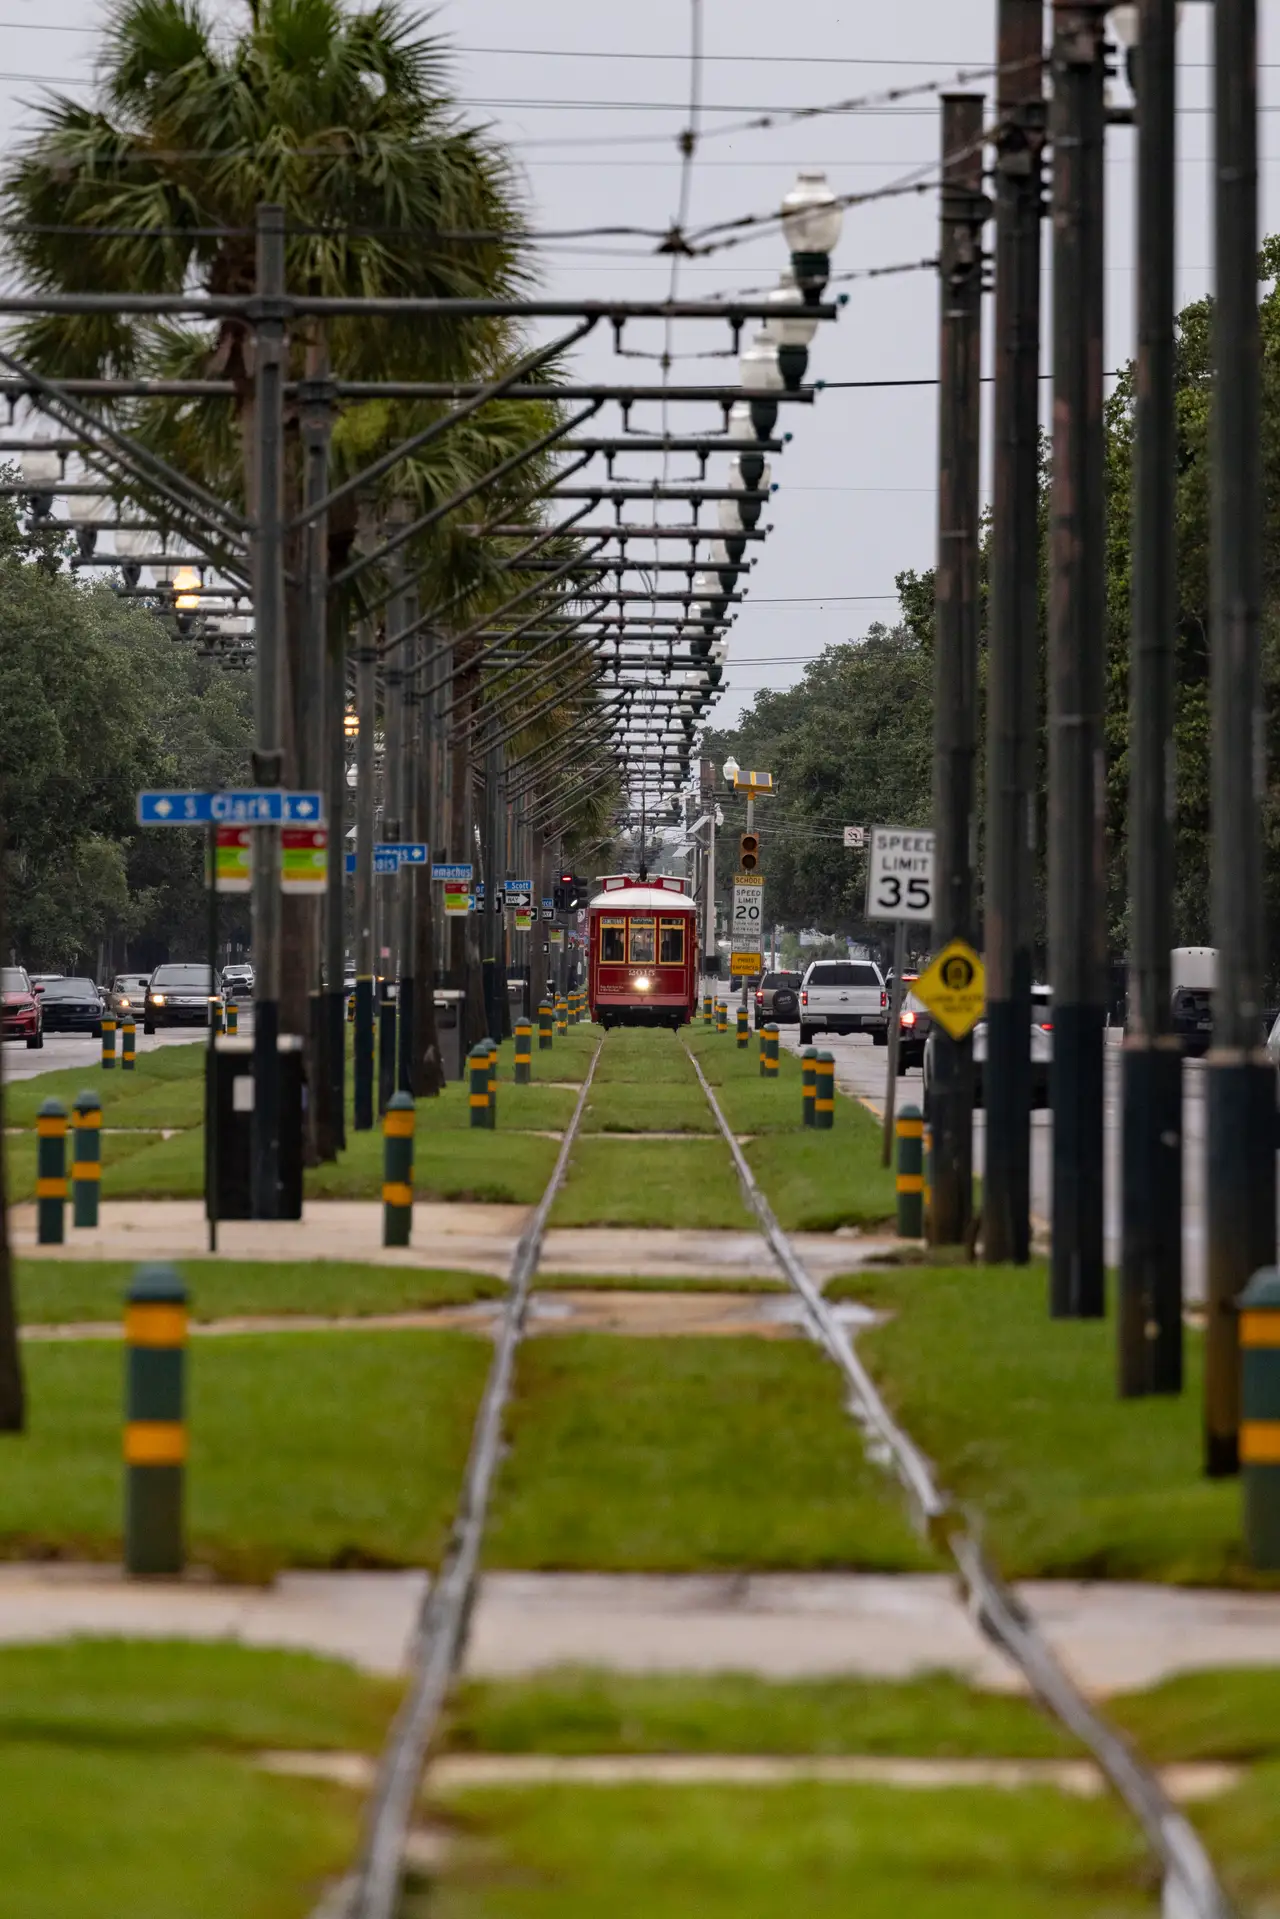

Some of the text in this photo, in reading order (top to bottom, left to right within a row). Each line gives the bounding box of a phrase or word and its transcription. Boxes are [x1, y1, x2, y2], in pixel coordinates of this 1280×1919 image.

[184, 796, 197, 818] S
[210, 794, 271, 819] Clark
[882, 857, 929, 871] LIMIT
[877, 876, 931, 910] 35
[735, 905, 760, 920] 20
